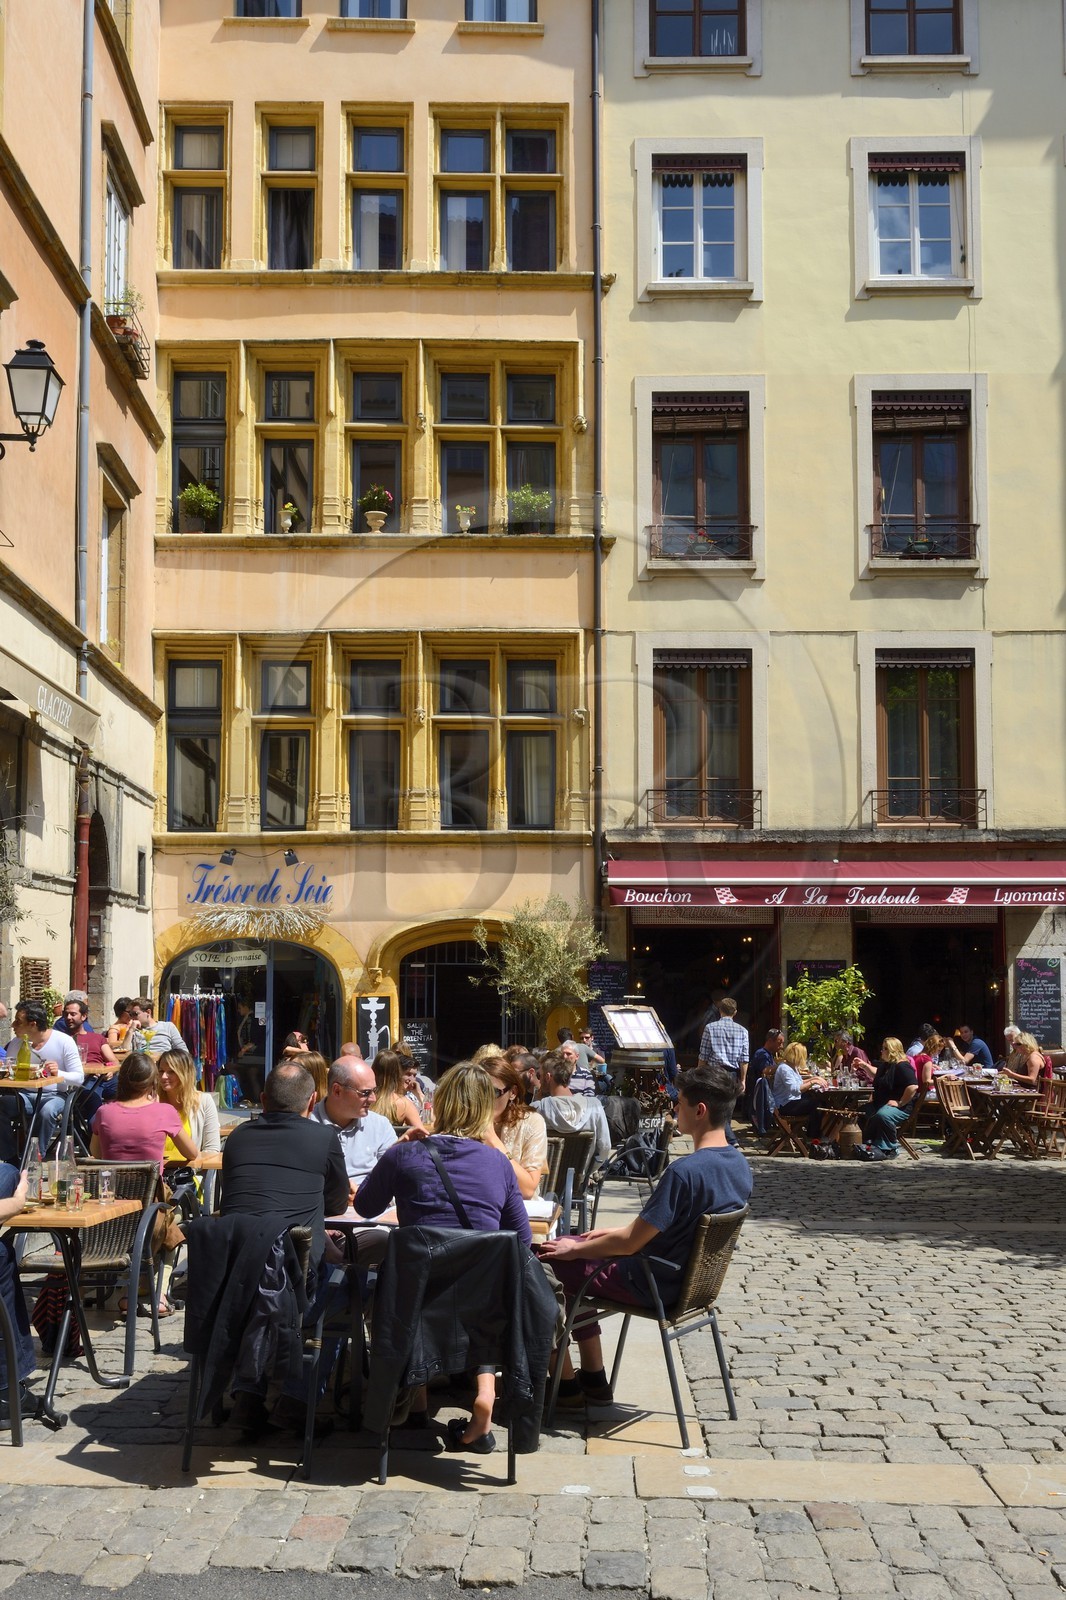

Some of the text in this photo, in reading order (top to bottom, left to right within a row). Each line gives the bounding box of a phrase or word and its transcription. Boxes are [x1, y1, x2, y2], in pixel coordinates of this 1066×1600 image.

[37, 685, 73, 728] GLACIER
[187, 862, 334, 904] Trésor de Soie
[624, 887, 1065, 904] Bouchon A La Traboule Lyonnais
[192, 952, 262, 965] SOIE Lyonnaise
